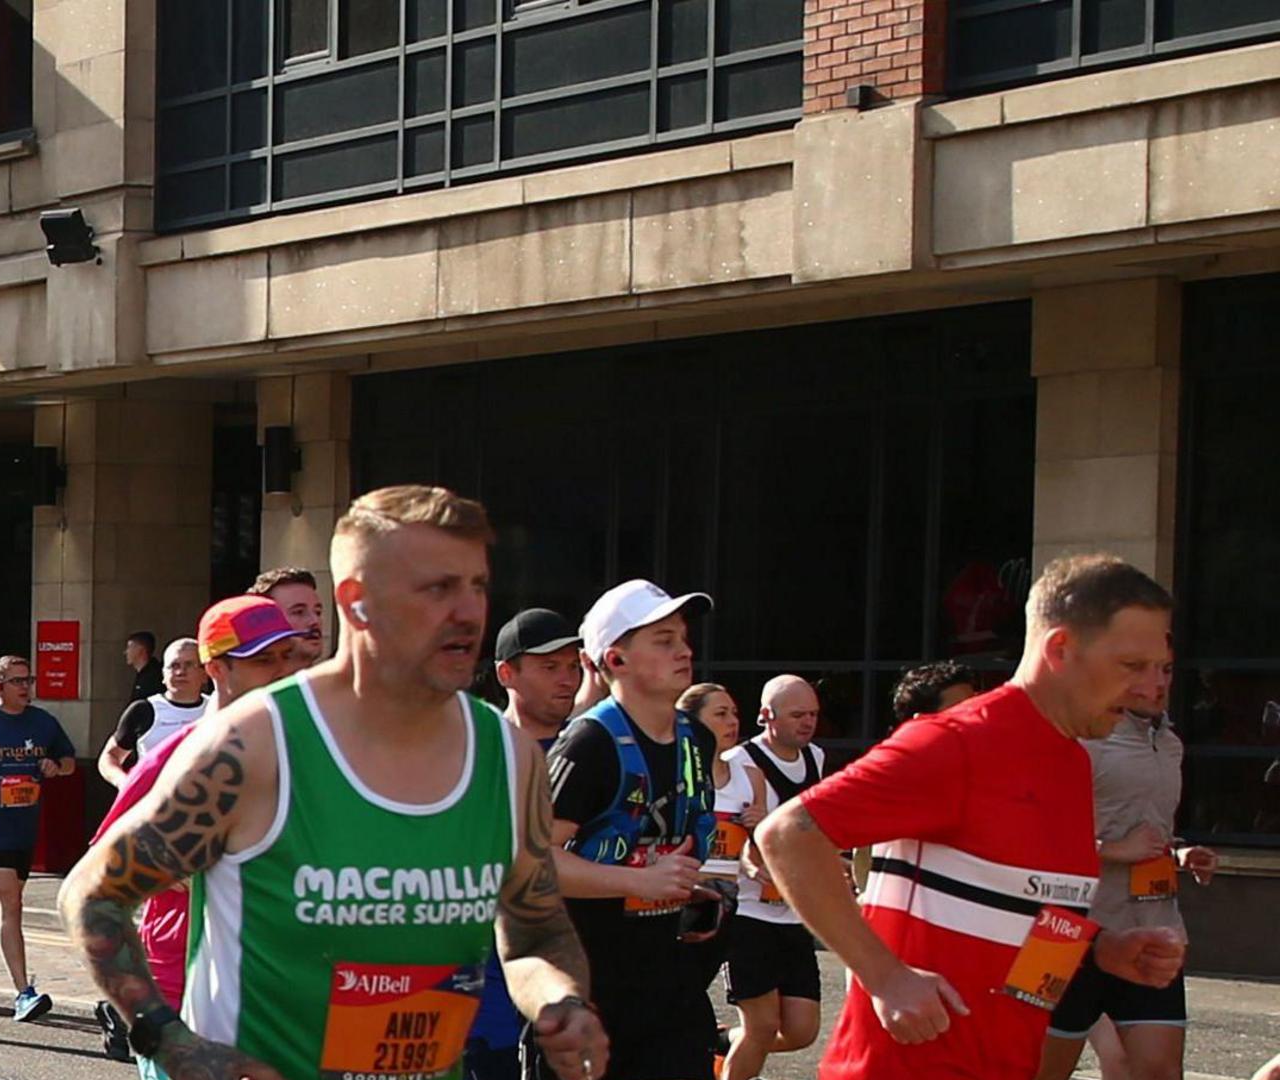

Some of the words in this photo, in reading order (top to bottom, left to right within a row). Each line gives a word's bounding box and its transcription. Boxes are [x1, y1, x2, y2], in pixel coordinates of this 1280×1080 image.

[295, 901, 406, 926] CANCER
[413, 898, 497, 924] SUPPOR
[354, 974, 411, 996] AJBell
[384, 1011, 441, 1040] ANDY
[372, 1041, 441, 1072] 21993
